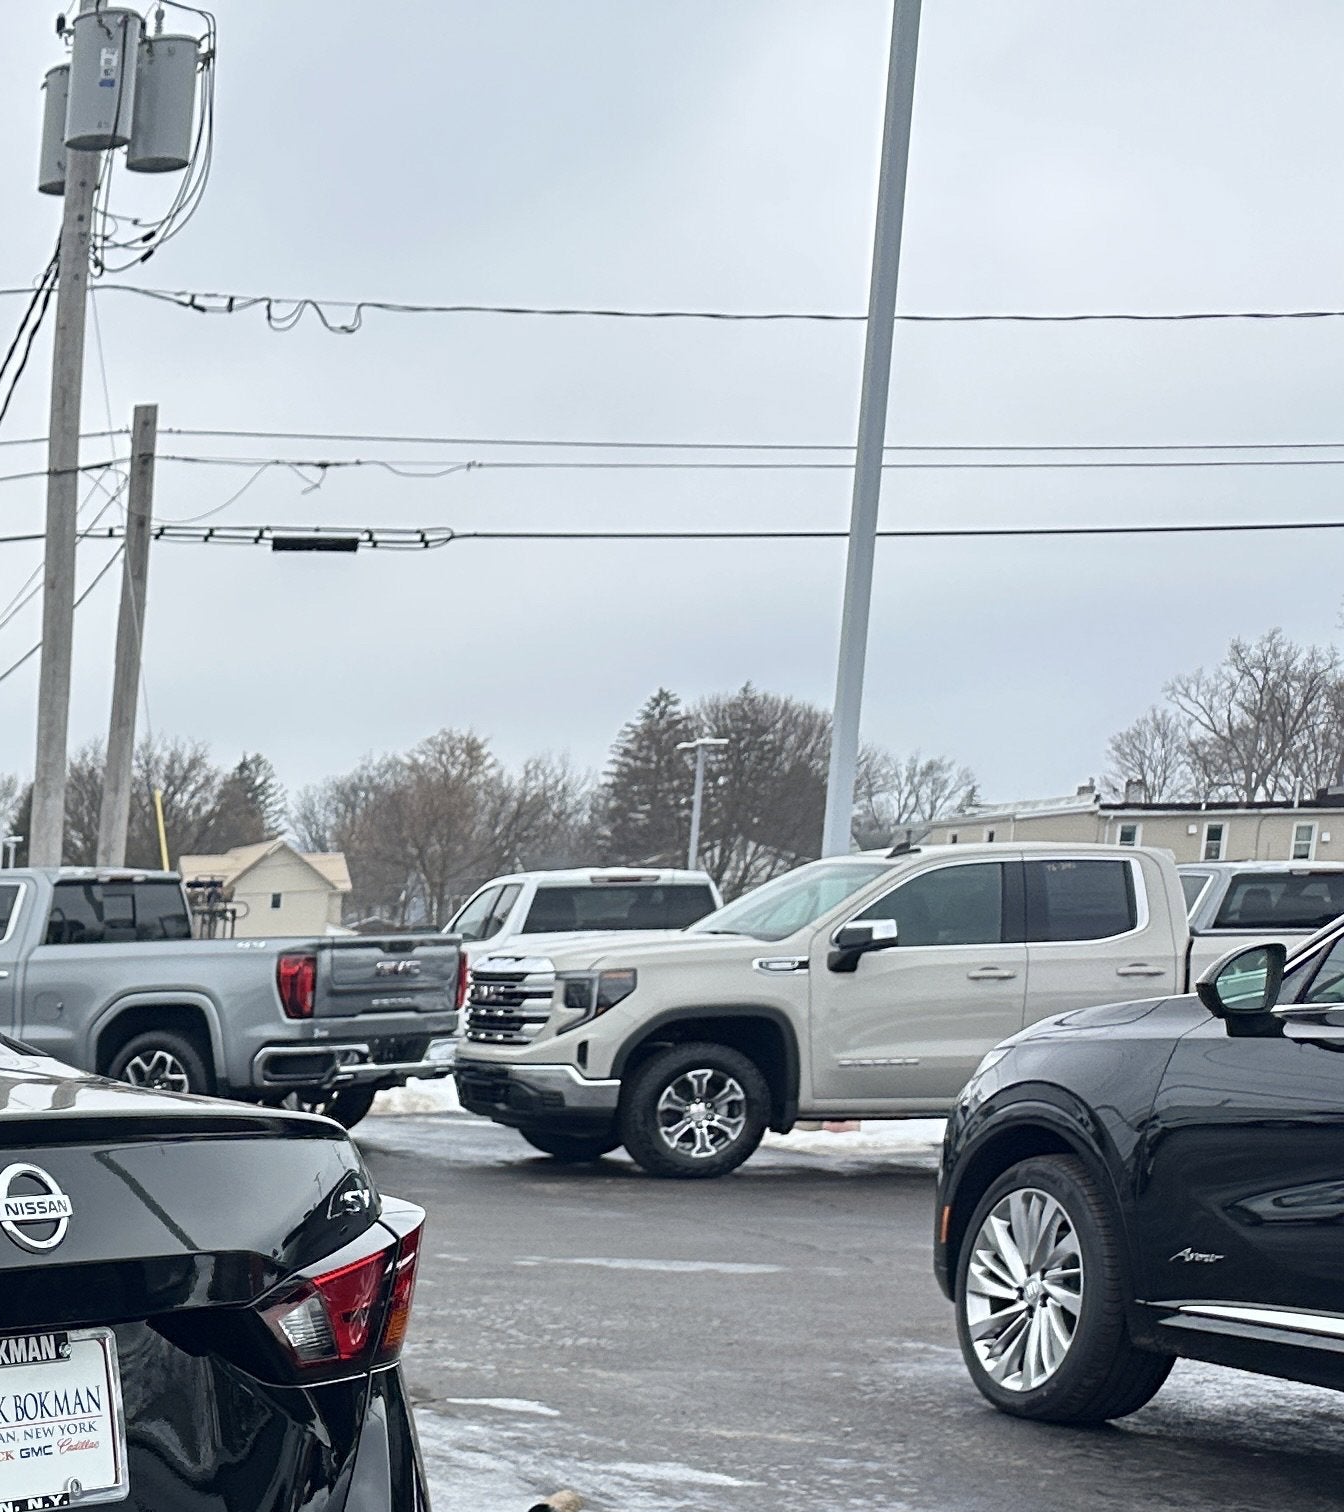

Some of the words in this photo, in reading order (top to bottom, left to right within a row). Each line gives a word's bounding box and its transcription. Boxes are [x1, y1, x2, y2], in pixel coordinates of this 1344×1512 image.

[4, 1199, 68, 1216] NISSAN
[13, 1384, 102, 1422] BOKMAN
[23, 1425, 56, 1440] NEW
[56, 1420, 98, 1435] YORK
[19, 1444, 54, 1458] GMC
[56, 1437, 101, 1454] Cadillac
[27, 1494, 69, 1511] N.Y.
